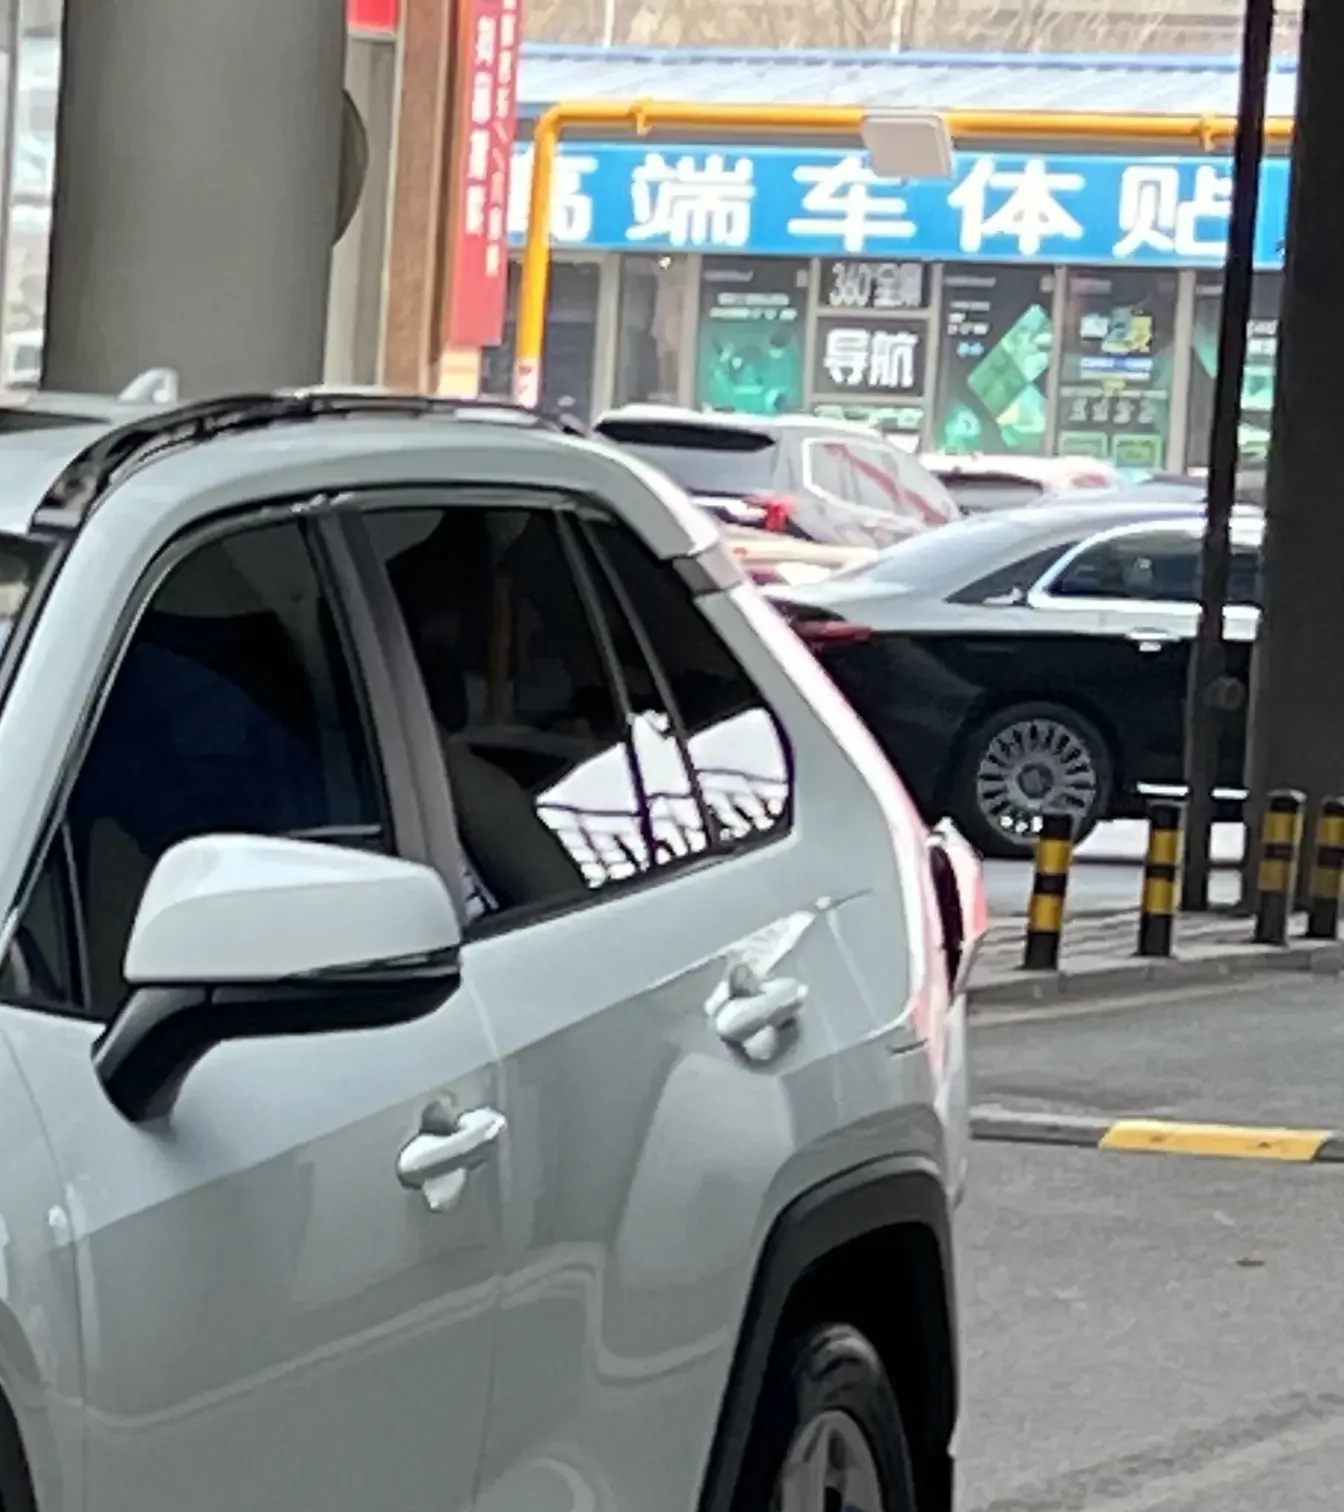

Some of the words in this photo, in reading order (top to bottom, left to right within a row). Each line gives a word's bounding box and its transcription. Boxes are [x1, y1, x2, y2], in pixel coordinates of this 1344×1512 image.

[507, 151, 1231, 256] 高端车体贴
[823, 329, 918, 387] 导航
